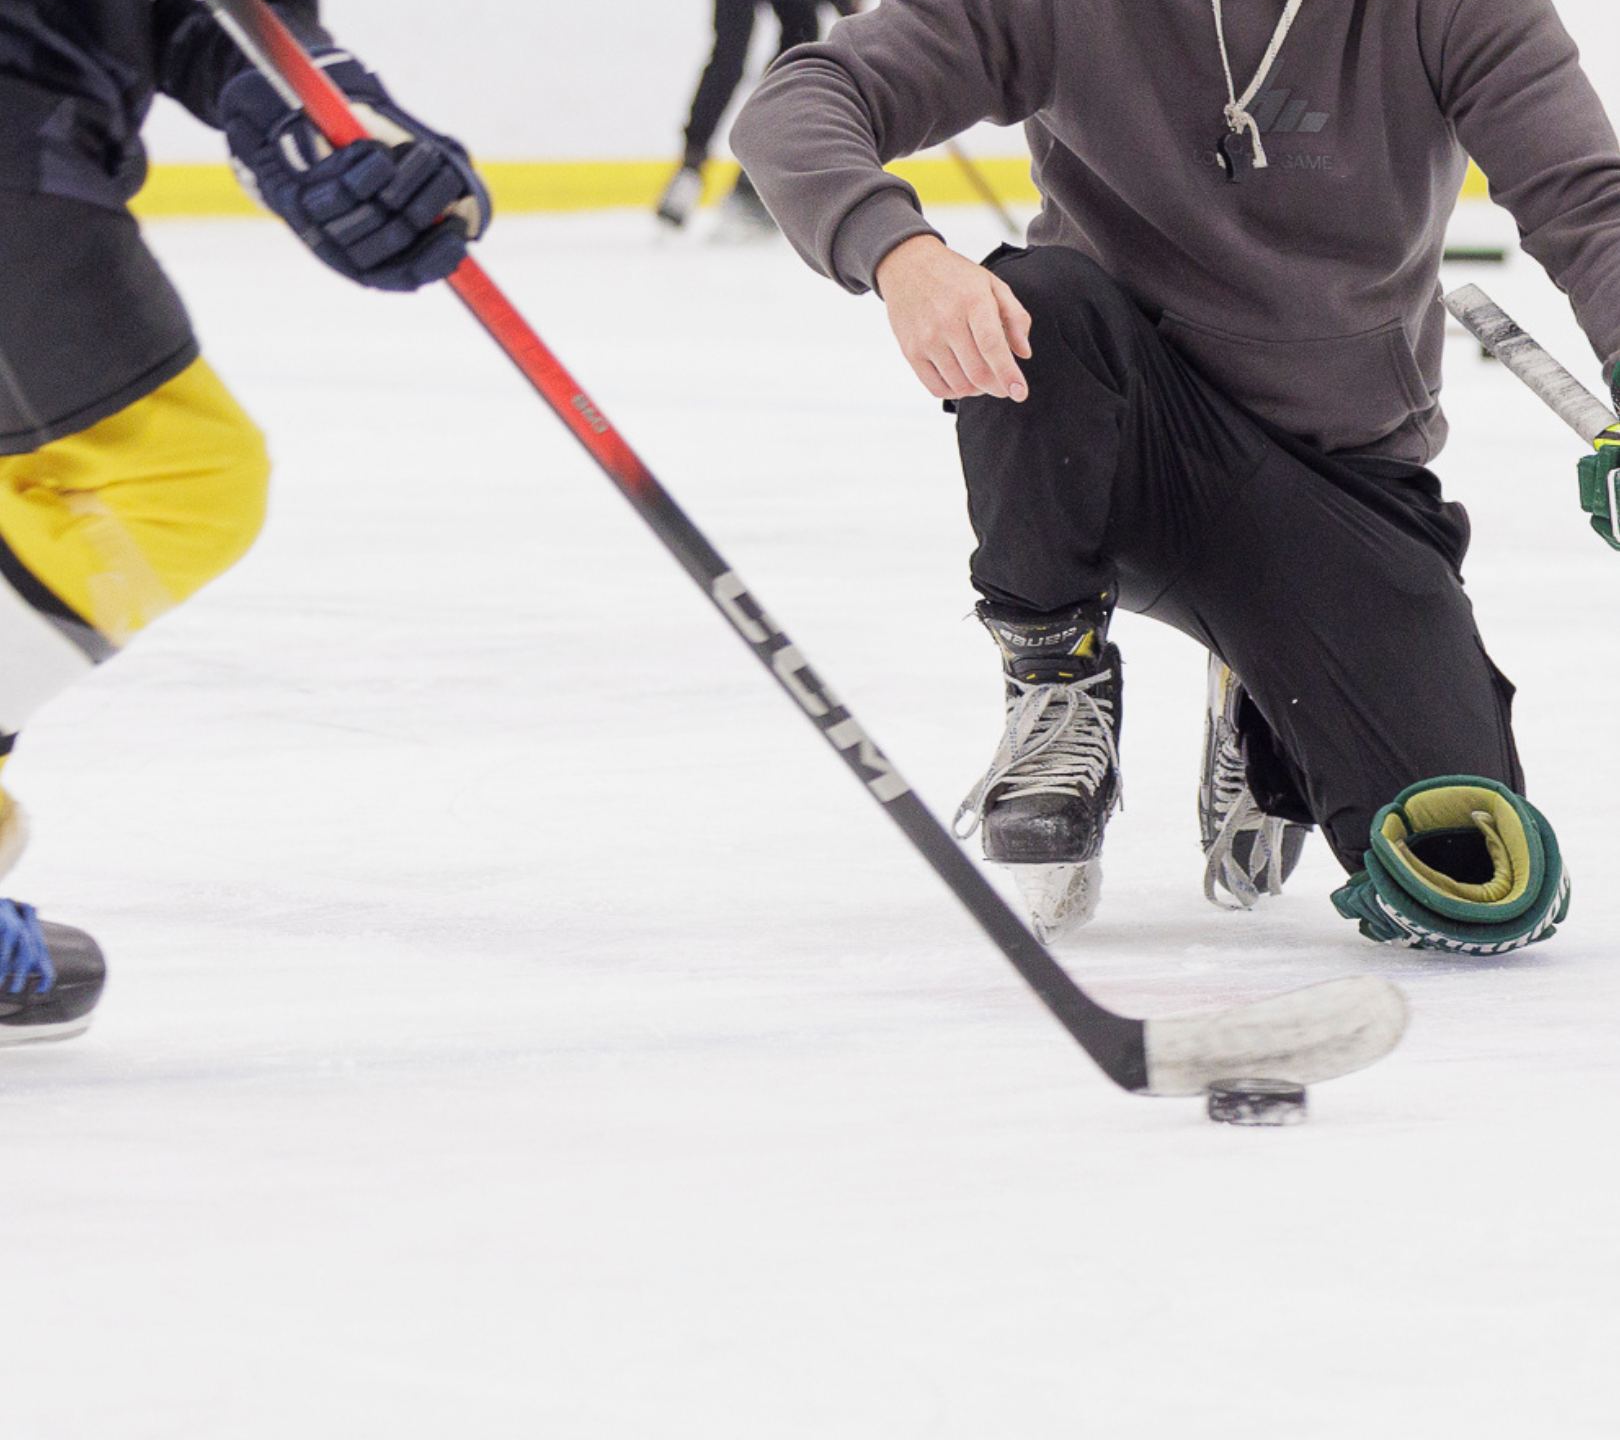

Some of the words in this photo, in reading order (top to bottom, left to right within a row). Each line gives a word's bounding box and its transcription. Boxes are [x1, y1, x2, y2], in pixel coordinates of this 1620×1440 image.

[1280, 154, 1334, 170] GAME
[1000, 626, 1077, 648] BAUER
[711, 570, 912, 803] CCM
